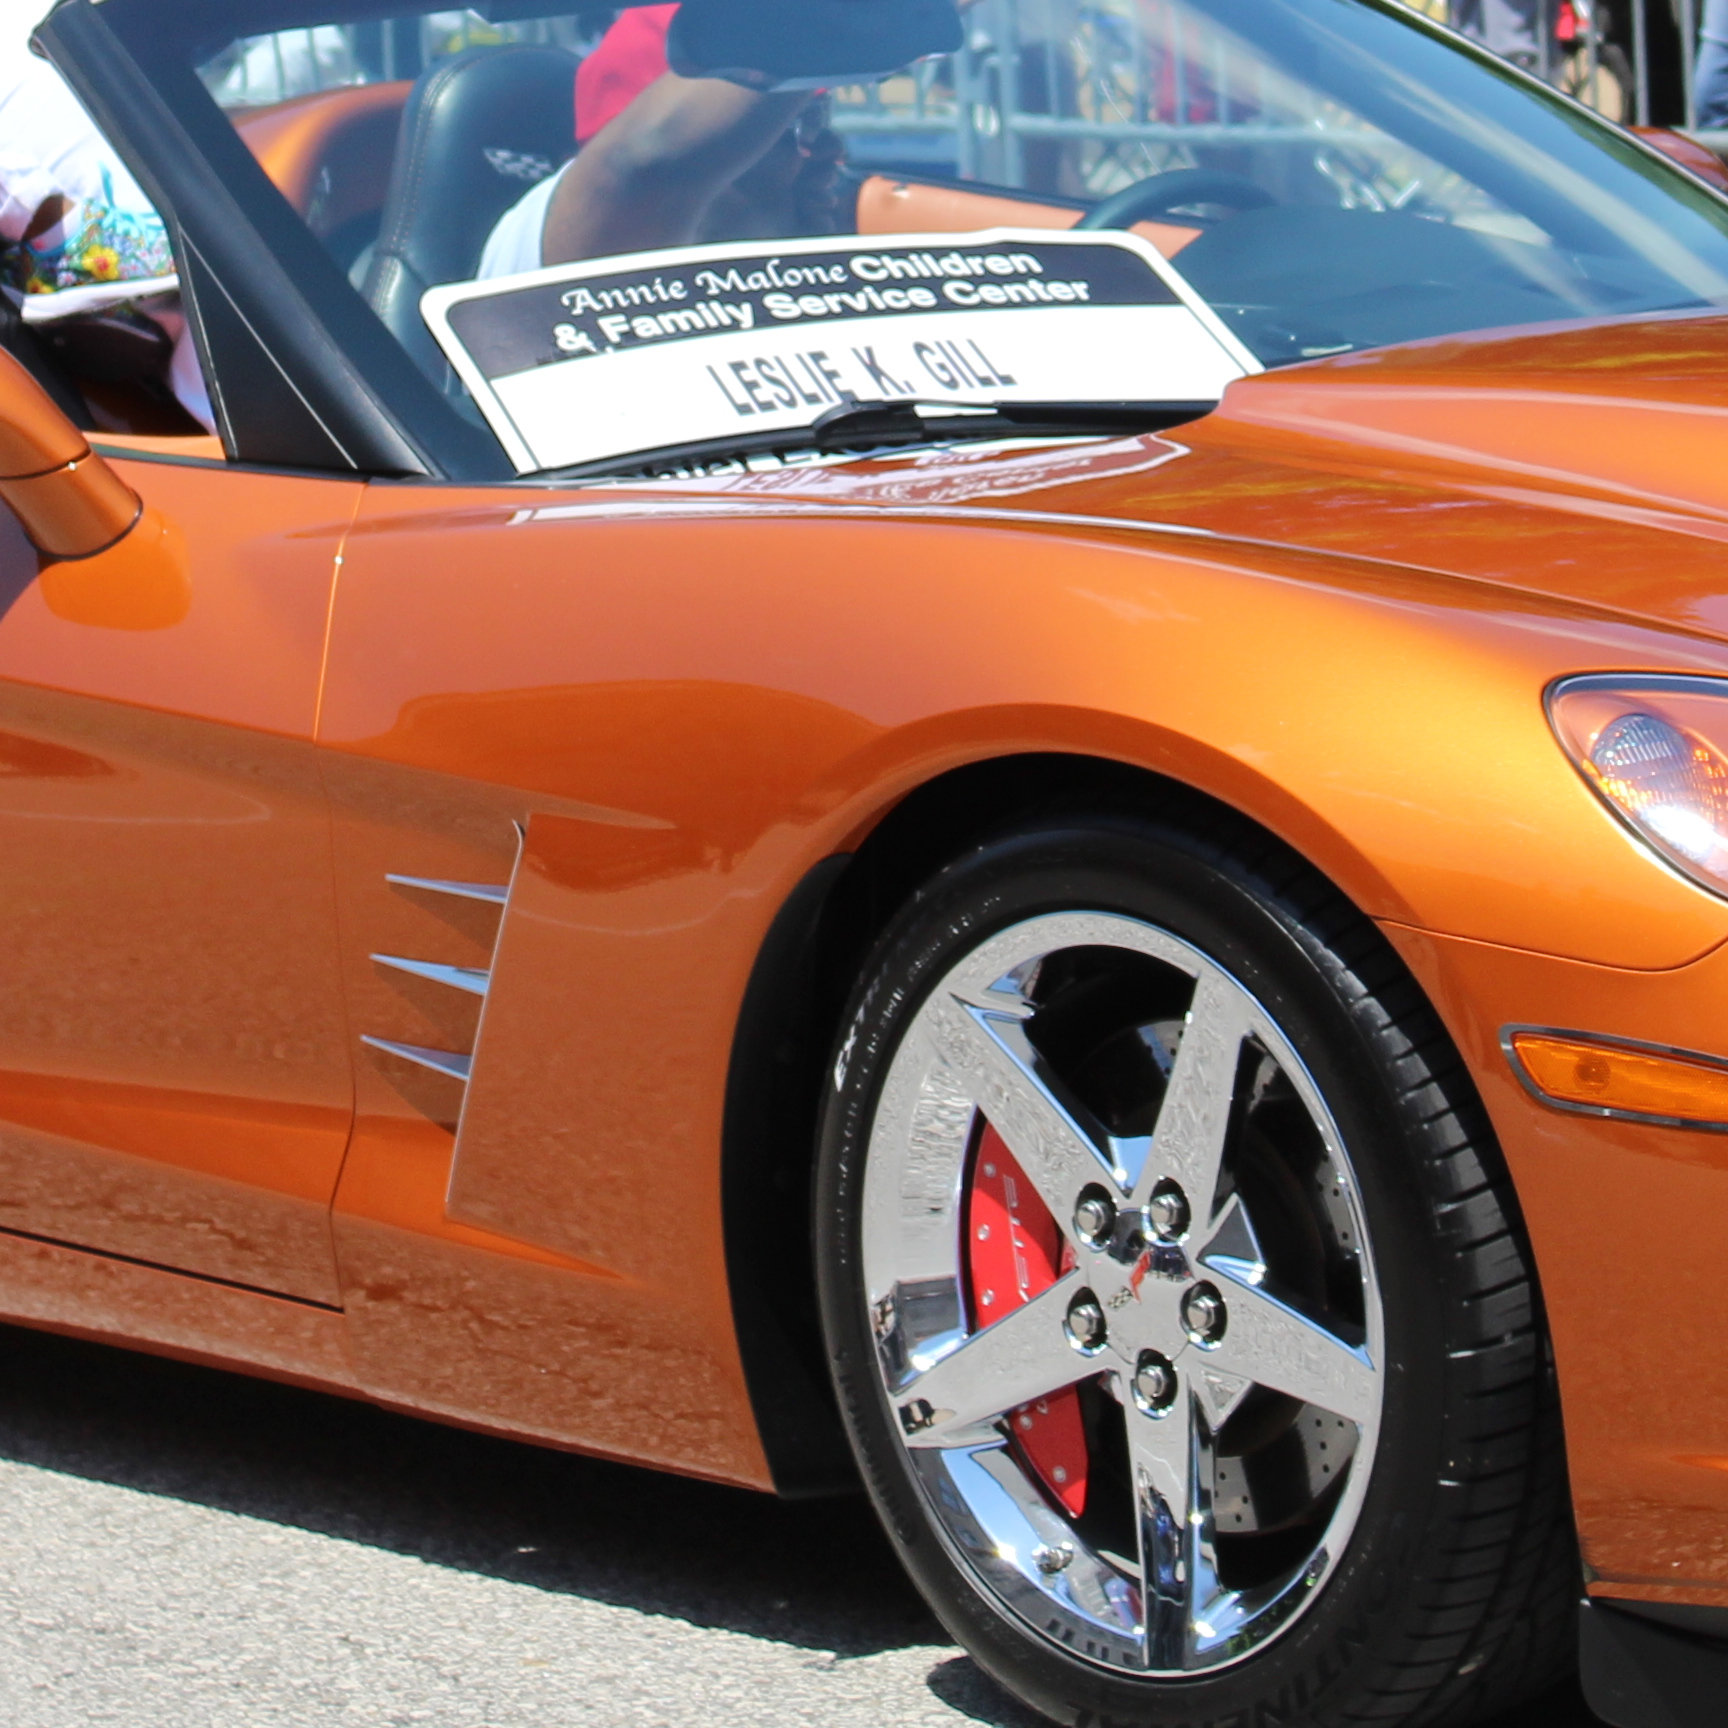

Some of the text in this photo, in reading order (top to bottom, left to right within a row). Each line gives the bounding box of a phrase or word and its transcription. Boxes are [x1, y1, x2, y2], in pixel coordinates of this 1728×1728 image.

[552, 278, 1091, 354] & Family Service Center
[559, 251, 1044, 316] Annie Malone Children
[705, 338, 1019, 417] LESLIE K. GILL
